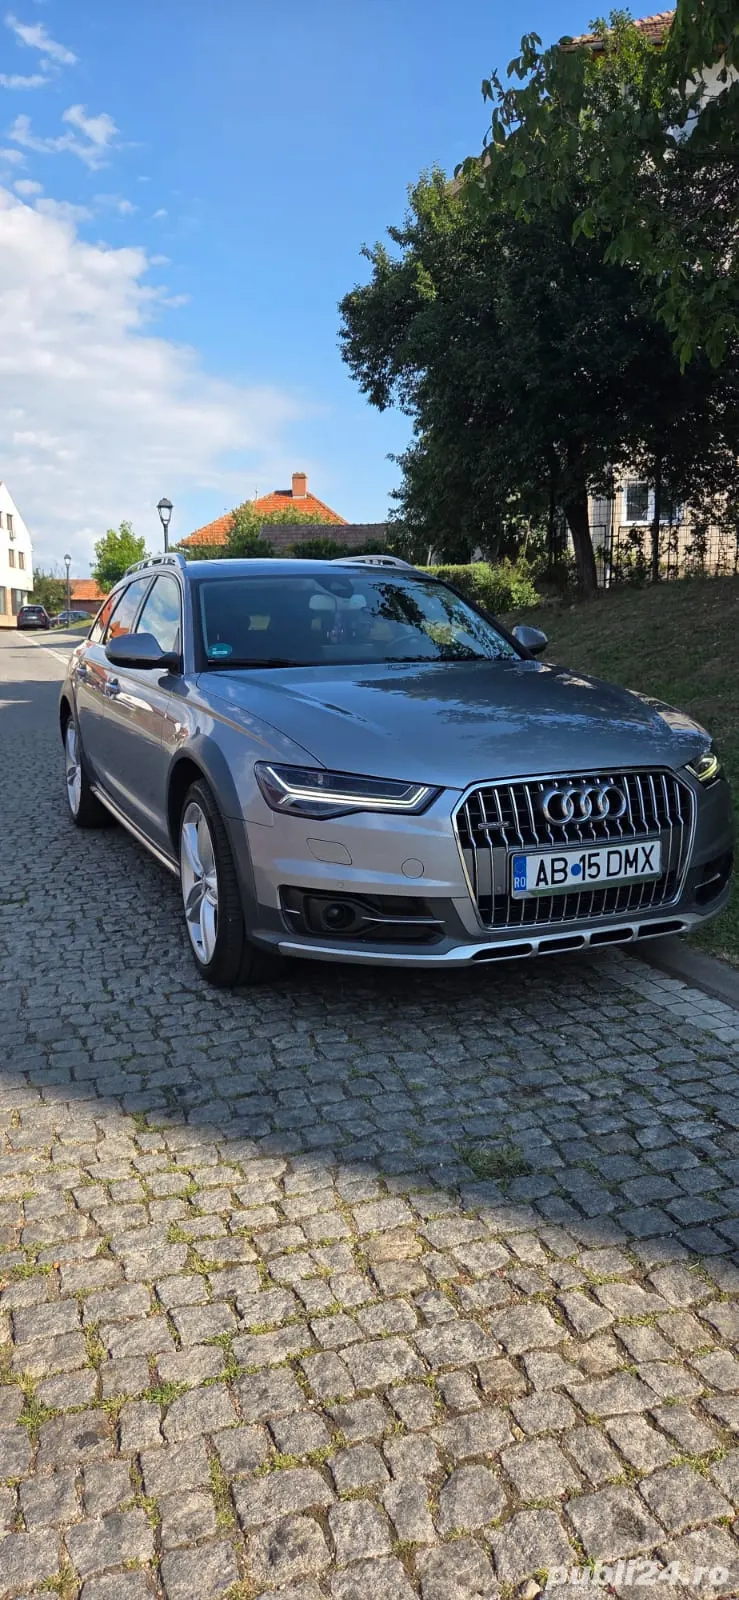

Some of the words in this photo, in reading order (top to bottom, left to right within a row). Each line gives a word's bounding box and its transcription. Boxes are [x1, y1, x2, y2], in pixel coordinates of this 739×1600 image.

[536, 857, 568, 886] AB
[579, 852, 600, 880] 15
[606, 845, 655, 877] DMX
[514, 877, 526, 888] RO
